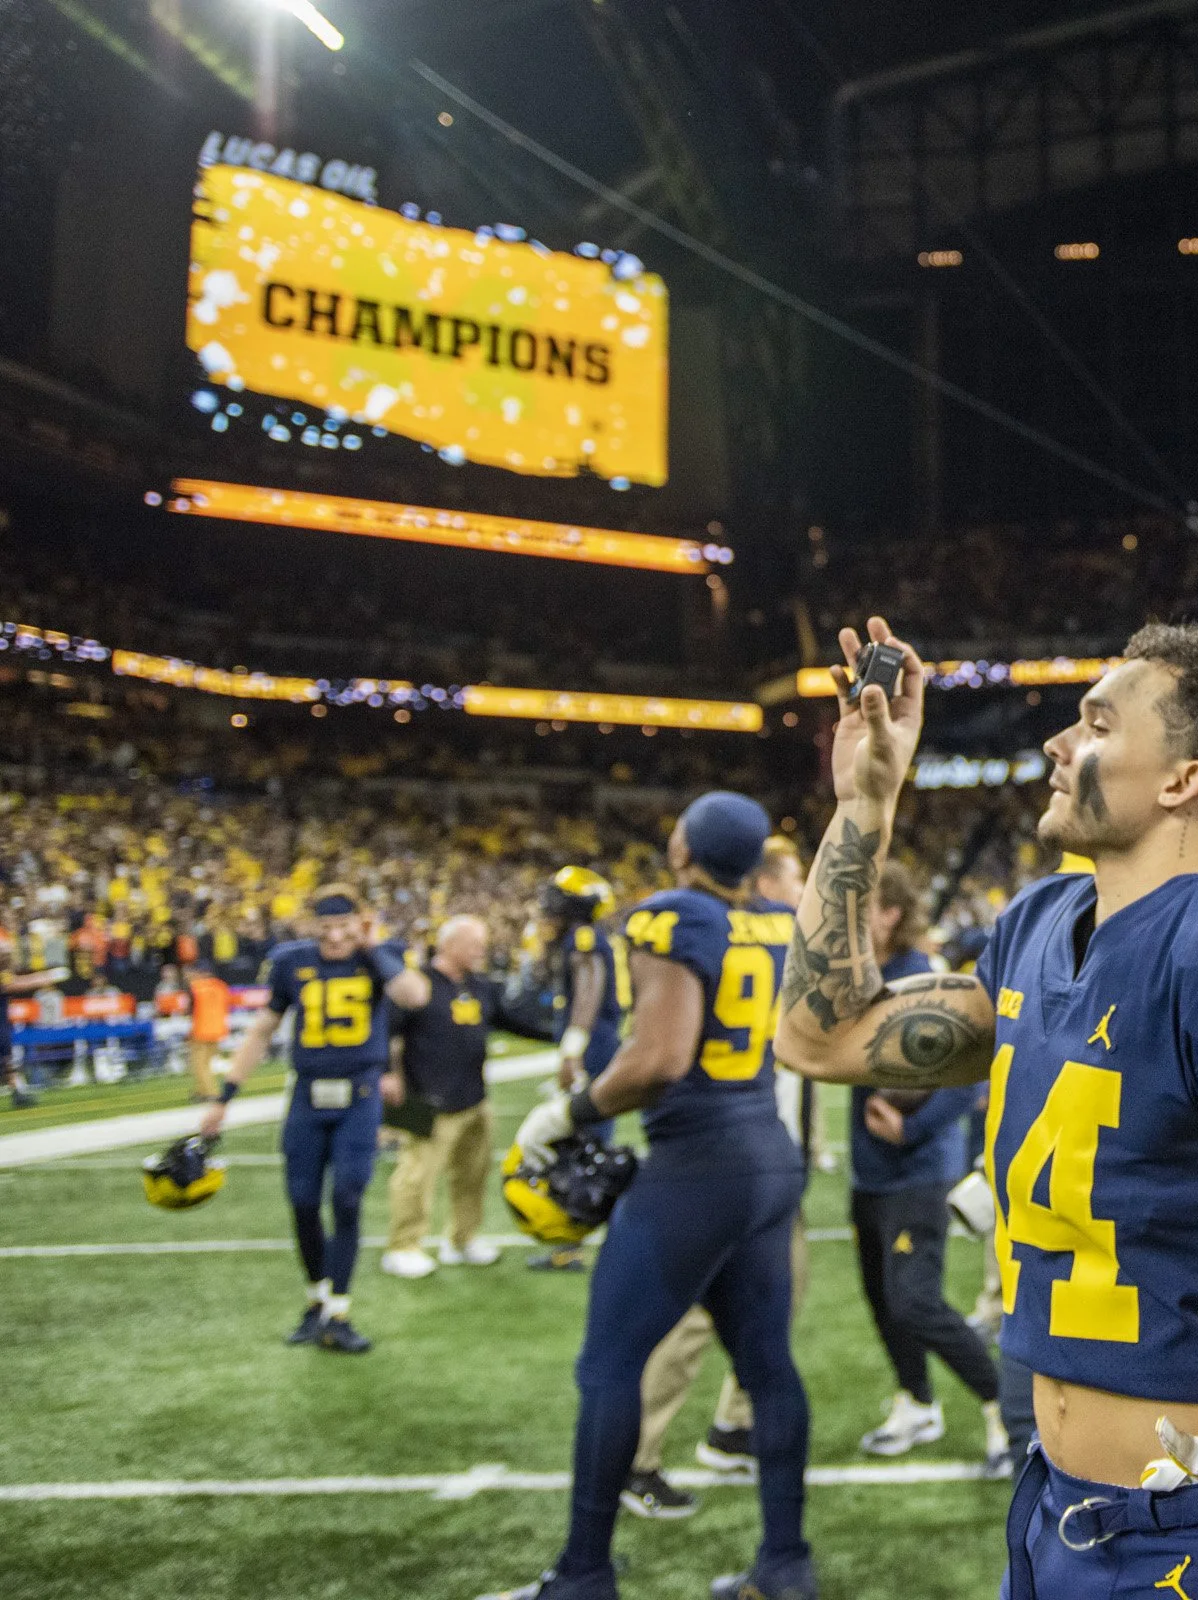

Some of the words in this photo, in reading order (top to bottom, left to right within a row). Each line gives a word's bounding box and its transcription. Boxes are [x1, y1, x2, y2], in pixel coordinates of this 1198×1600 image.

[201, 130, 322, 184] LUCAS
[320, 159, 378, 202] OIL
[261, 281, 612, 385] CHAMPIONS
[300, 974, 372, 1049] 15
[701, 945, 783, 1082] 9
[985, 1043, 1140, 1344] 14
